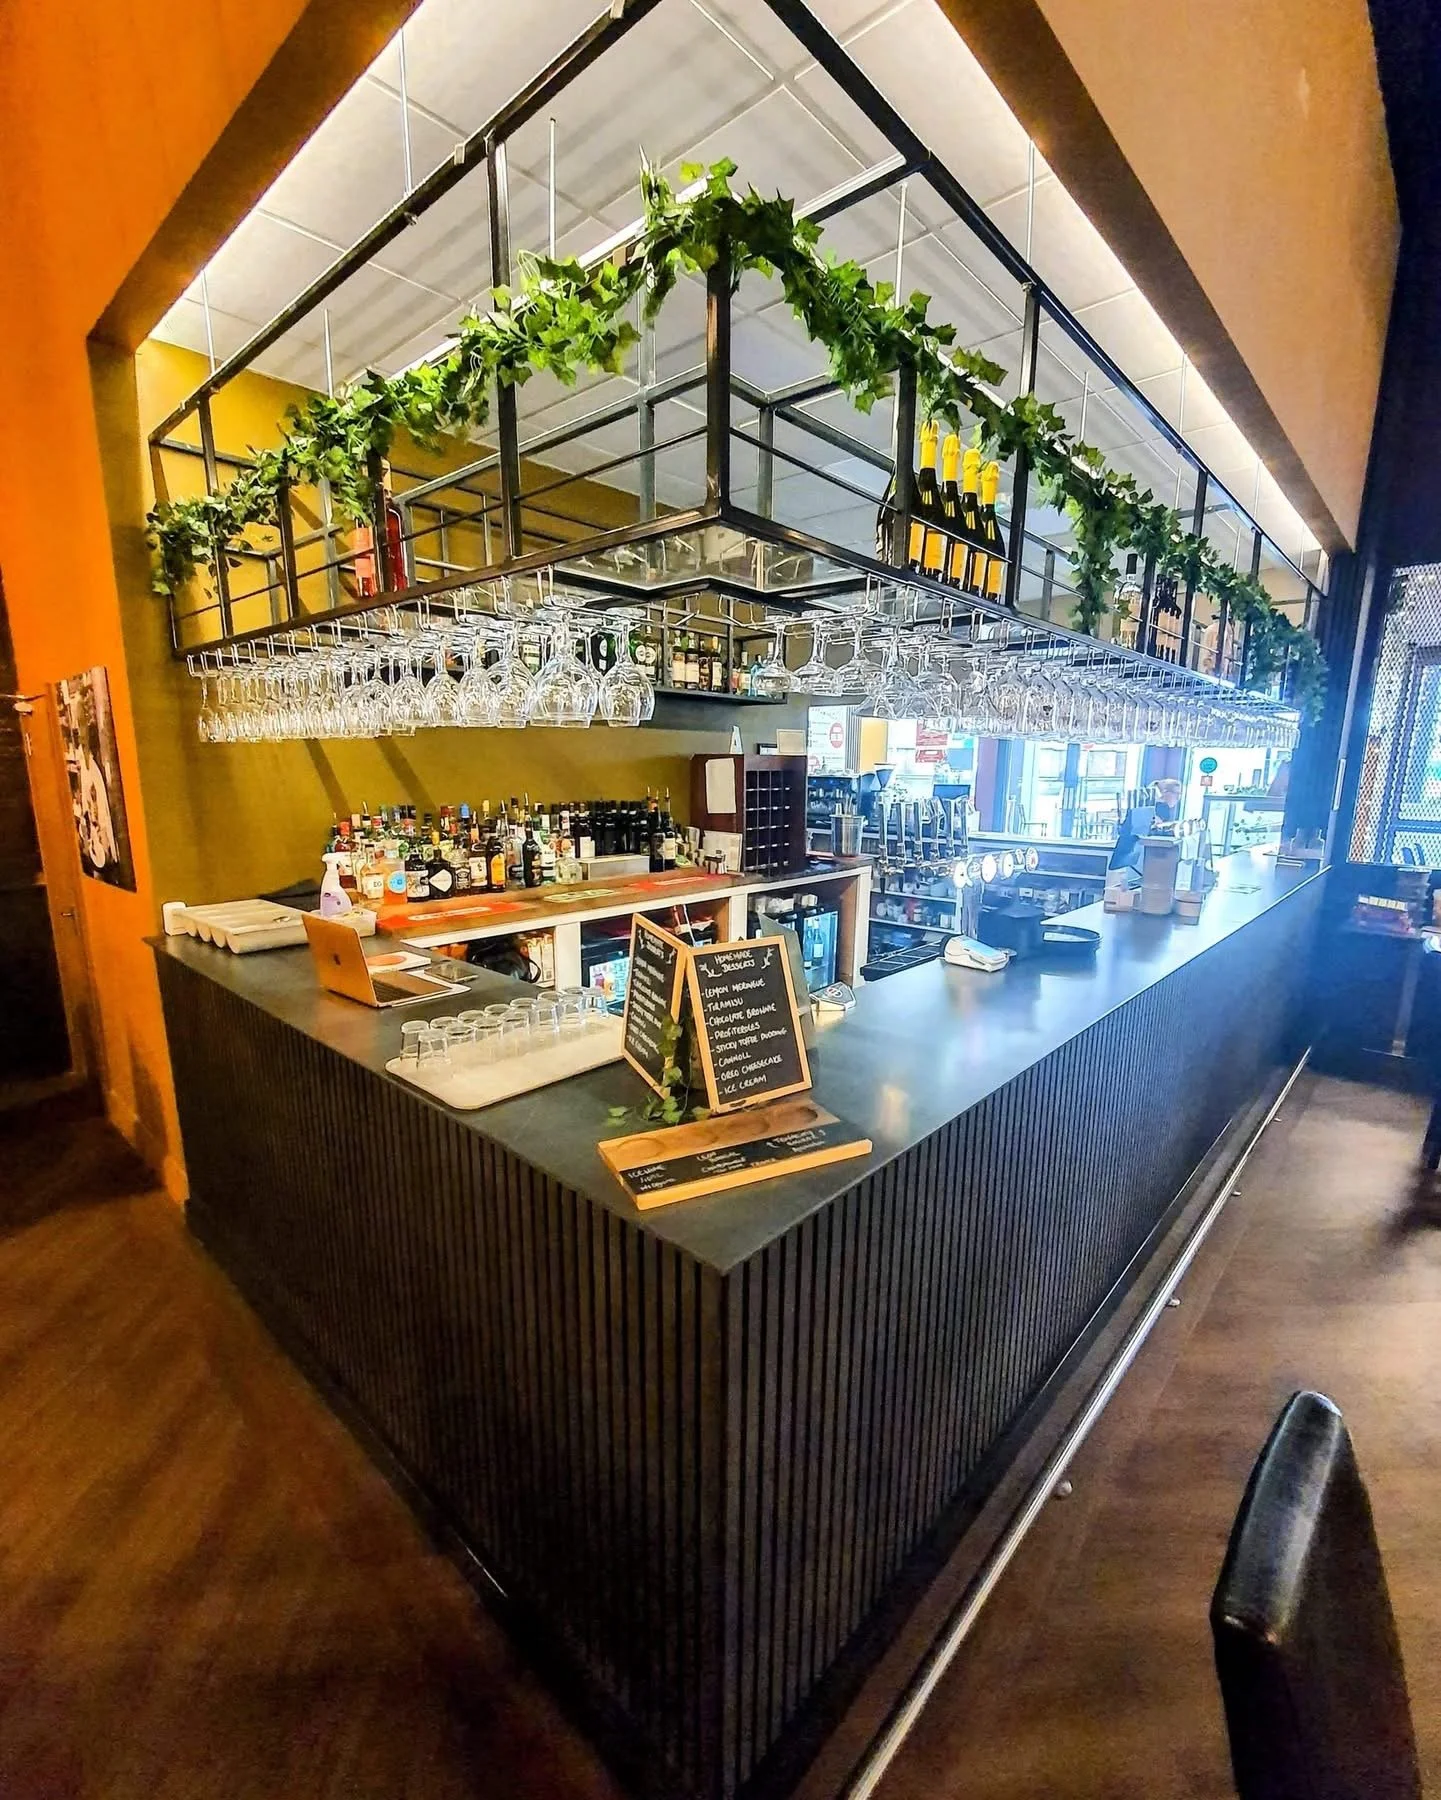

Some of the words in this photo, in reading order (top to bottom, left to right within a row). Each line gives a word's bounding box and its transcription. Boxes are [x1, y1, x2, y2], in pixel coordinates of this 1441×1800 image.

[714, 950, 753, 965] HOMEMADE
[704, 985, 729, 998] LEMON
[731, 978, 766, 992] MERINGUE
[707, 998, 744, 1012] TIRAMISU
[708, 1011, 744, 1026] CHOCOLATE
[746, 1003, 777, 1019] BROWNIE
[714, 1022, 761, 1040] PROFITEROLES
[720, 1070, 740, 1081] OREO
[741, 1055, 783, 1074] CHEESECAKE
[724, 1083, 738, 1094] ICE
[739, 1074, 767, 1089] CREAM
